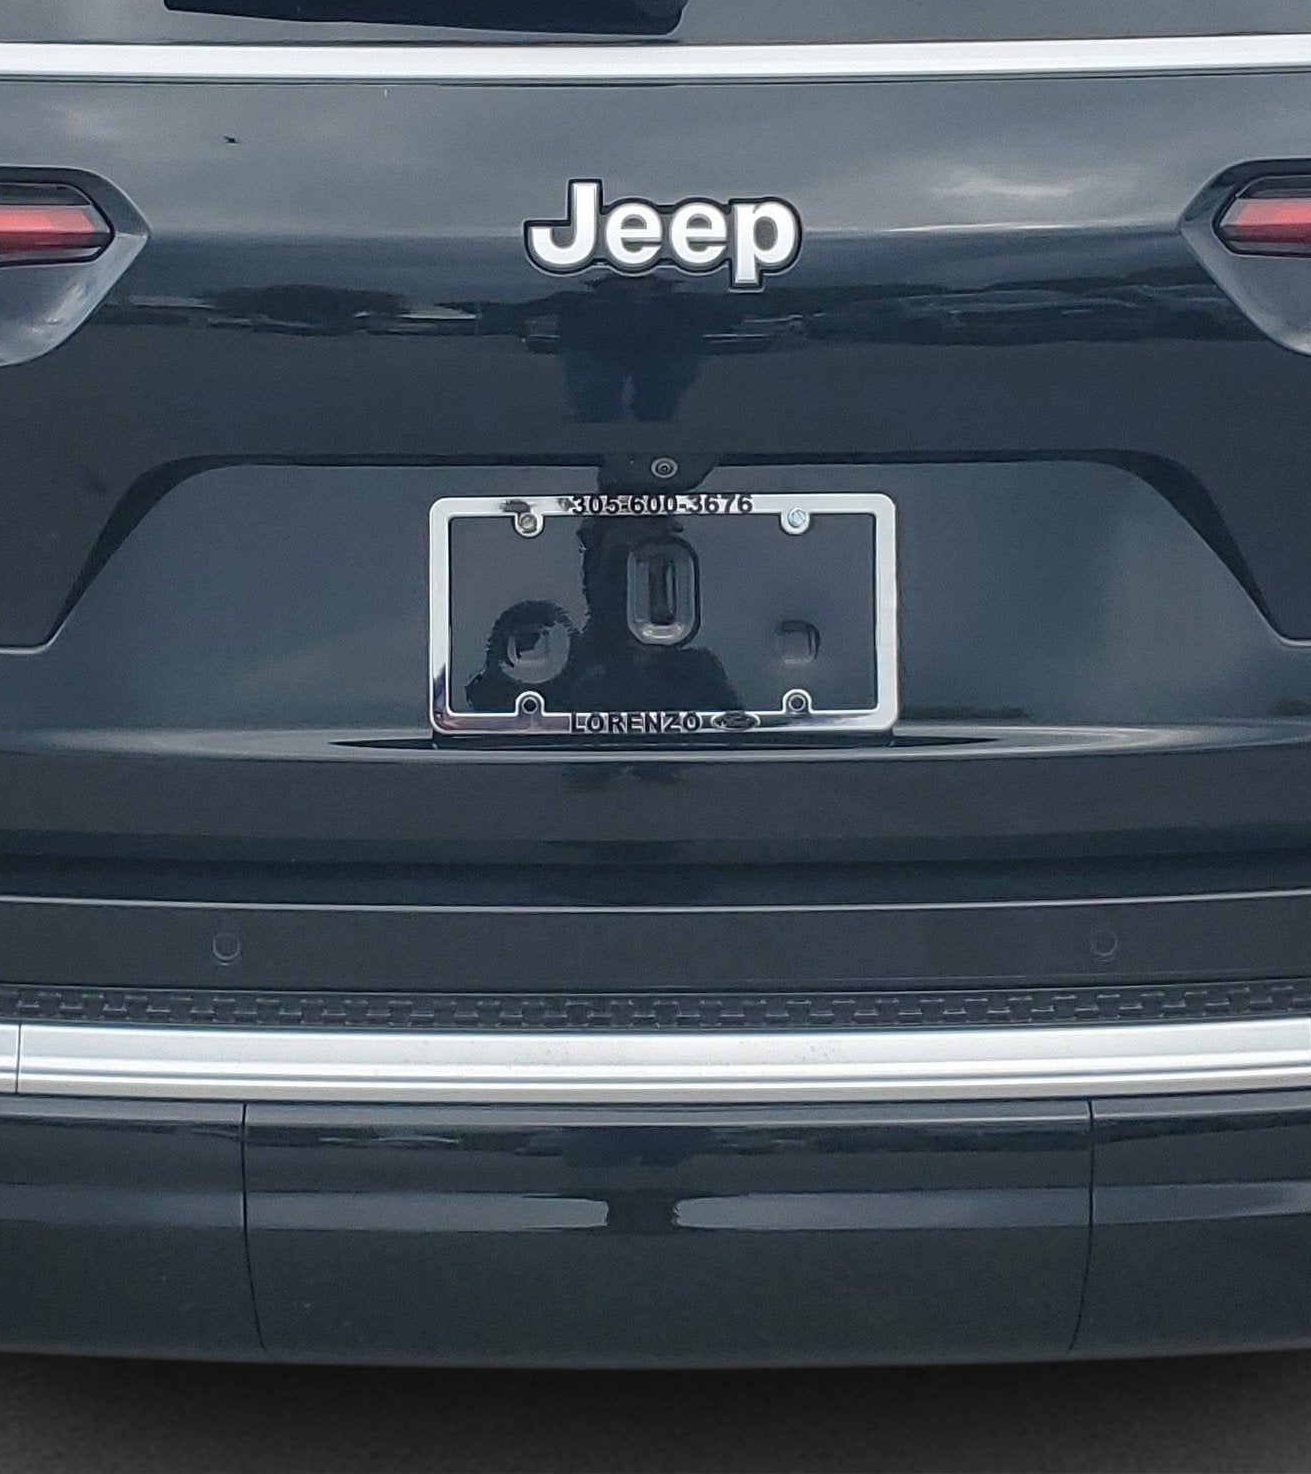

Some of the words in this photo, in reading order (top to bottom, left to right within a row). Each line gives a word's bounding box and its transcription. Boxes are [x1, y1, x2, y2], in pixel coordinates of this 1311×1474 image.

[523, 178, 802, 291] Jeep
[572, 494, 753, 514] 305-600-3676
[570, 711, 702, 733] LORENZO
